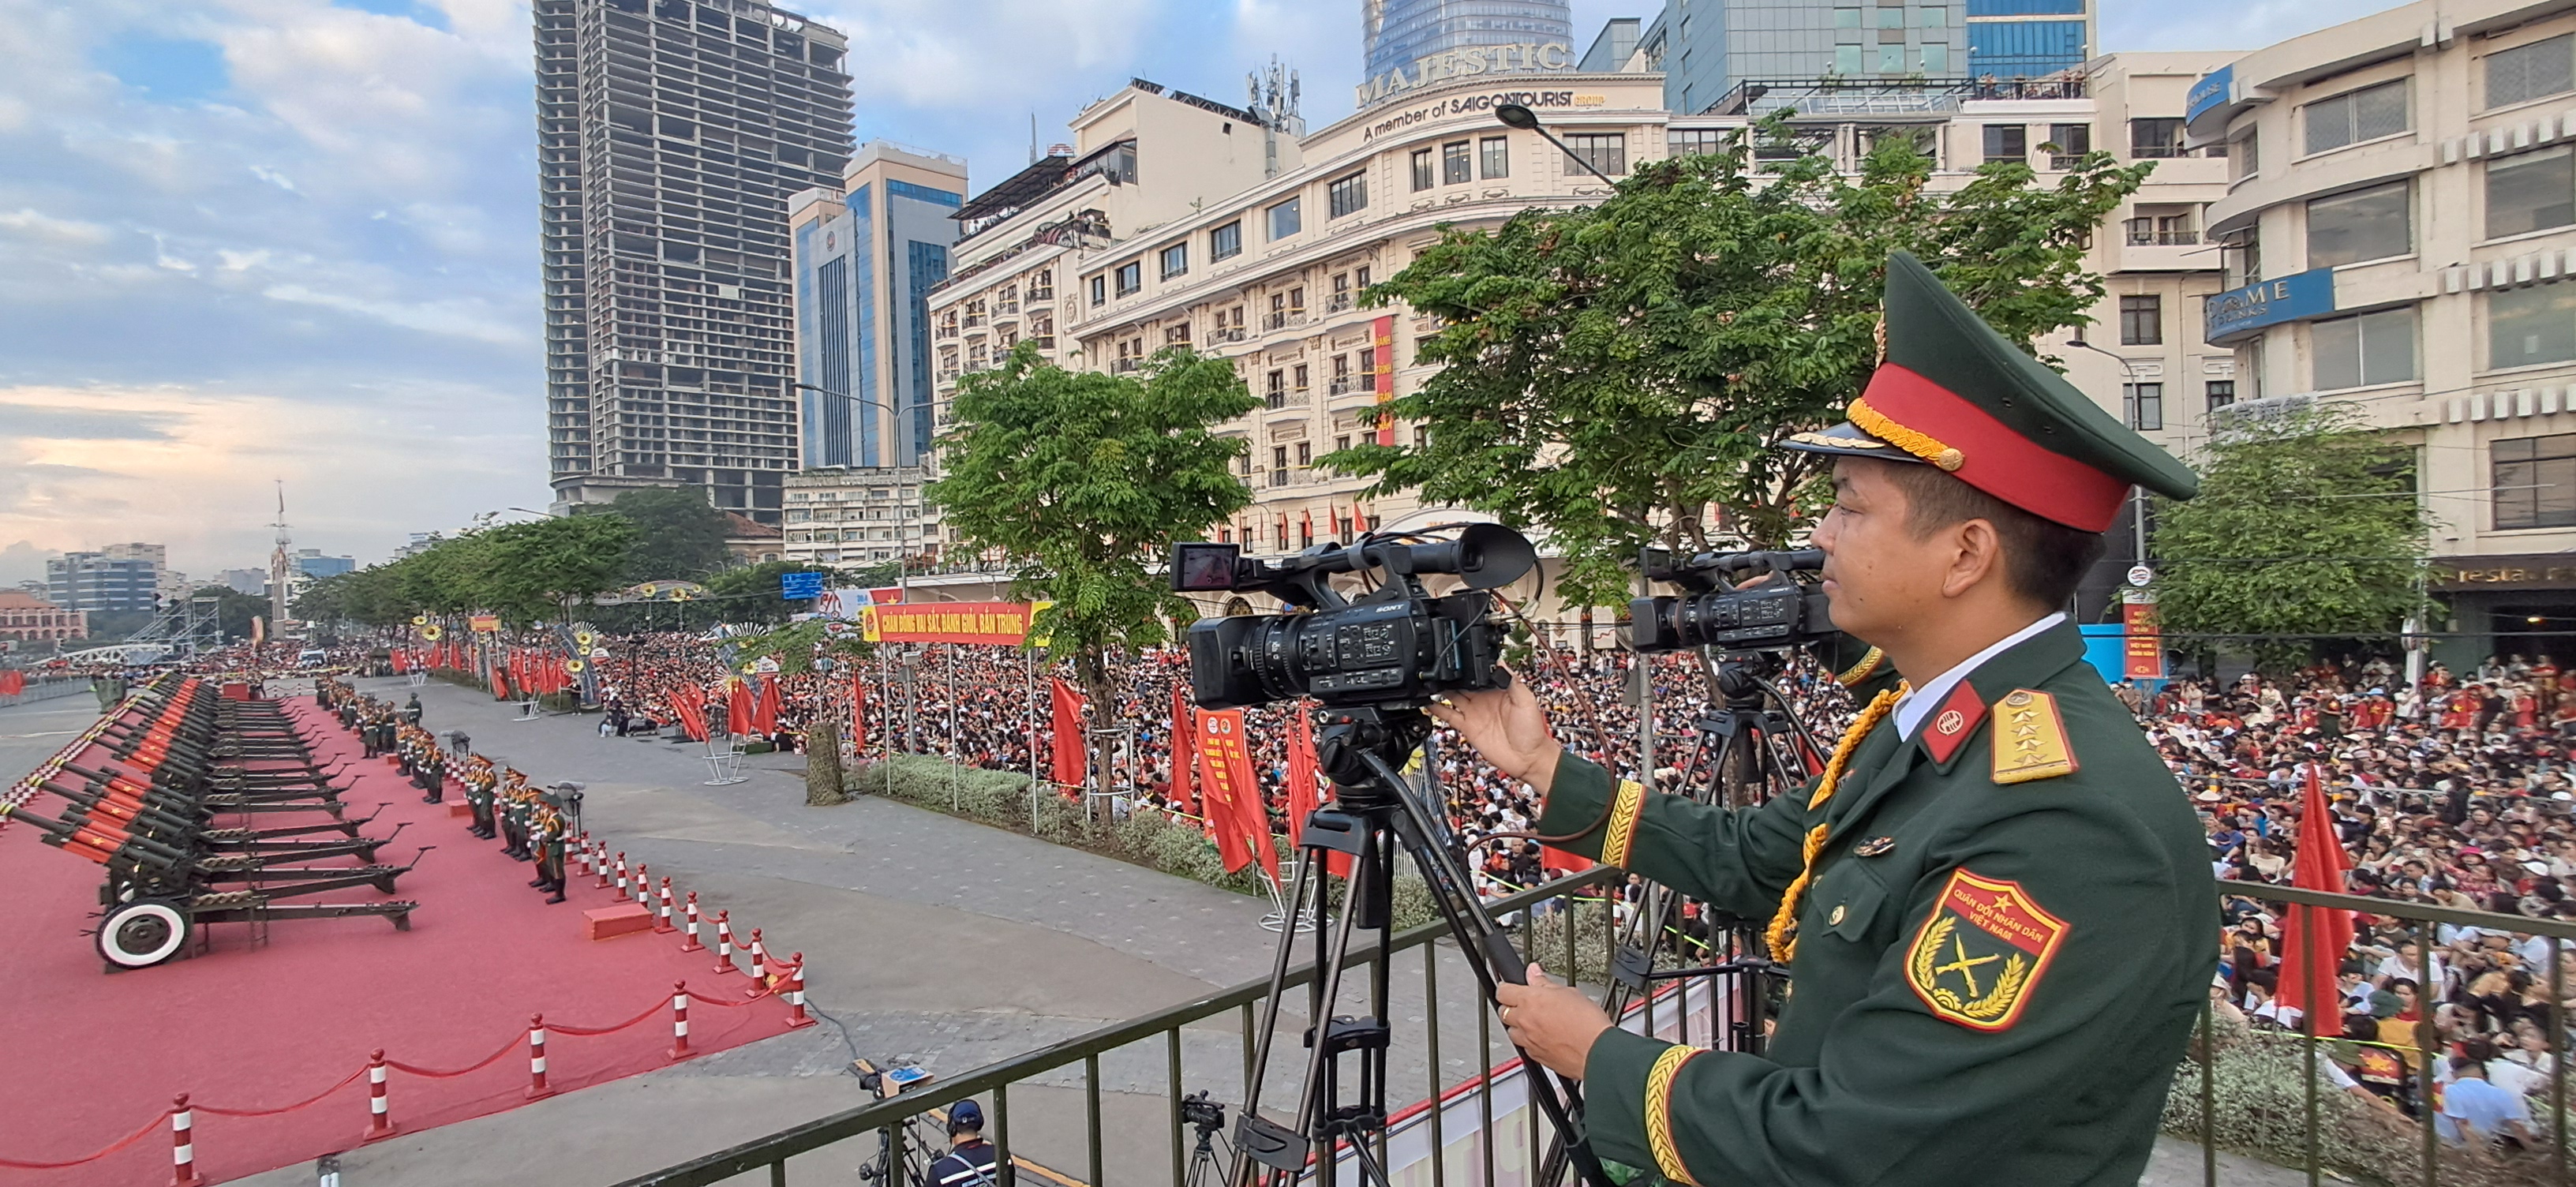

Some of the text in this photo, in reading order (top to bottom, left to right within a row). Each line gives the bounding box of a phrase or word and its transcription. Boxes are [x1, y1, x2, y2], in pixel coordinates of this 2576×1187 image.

[1356, 43, 1567, 109] MAJESTIC
[1363, 127, 1373, 142] A
[1375, 107, 1428, 137] member
[1432, 101, 1447, 118] of
[1451, 91, 1574, 114] SAIGONTOURIST
[915, 613, 927, 633] VAI
[979, 605, 996, 634] BẮN
[996, 608, 1023, 635] TRÚNG
[1376, 604, 1404, 613] SONY
[1953, 888, 2044, 943] QUÂN ĐỘI NHÂN DÂN
[1968, 911, 2013, 941] VIỆT NAM
